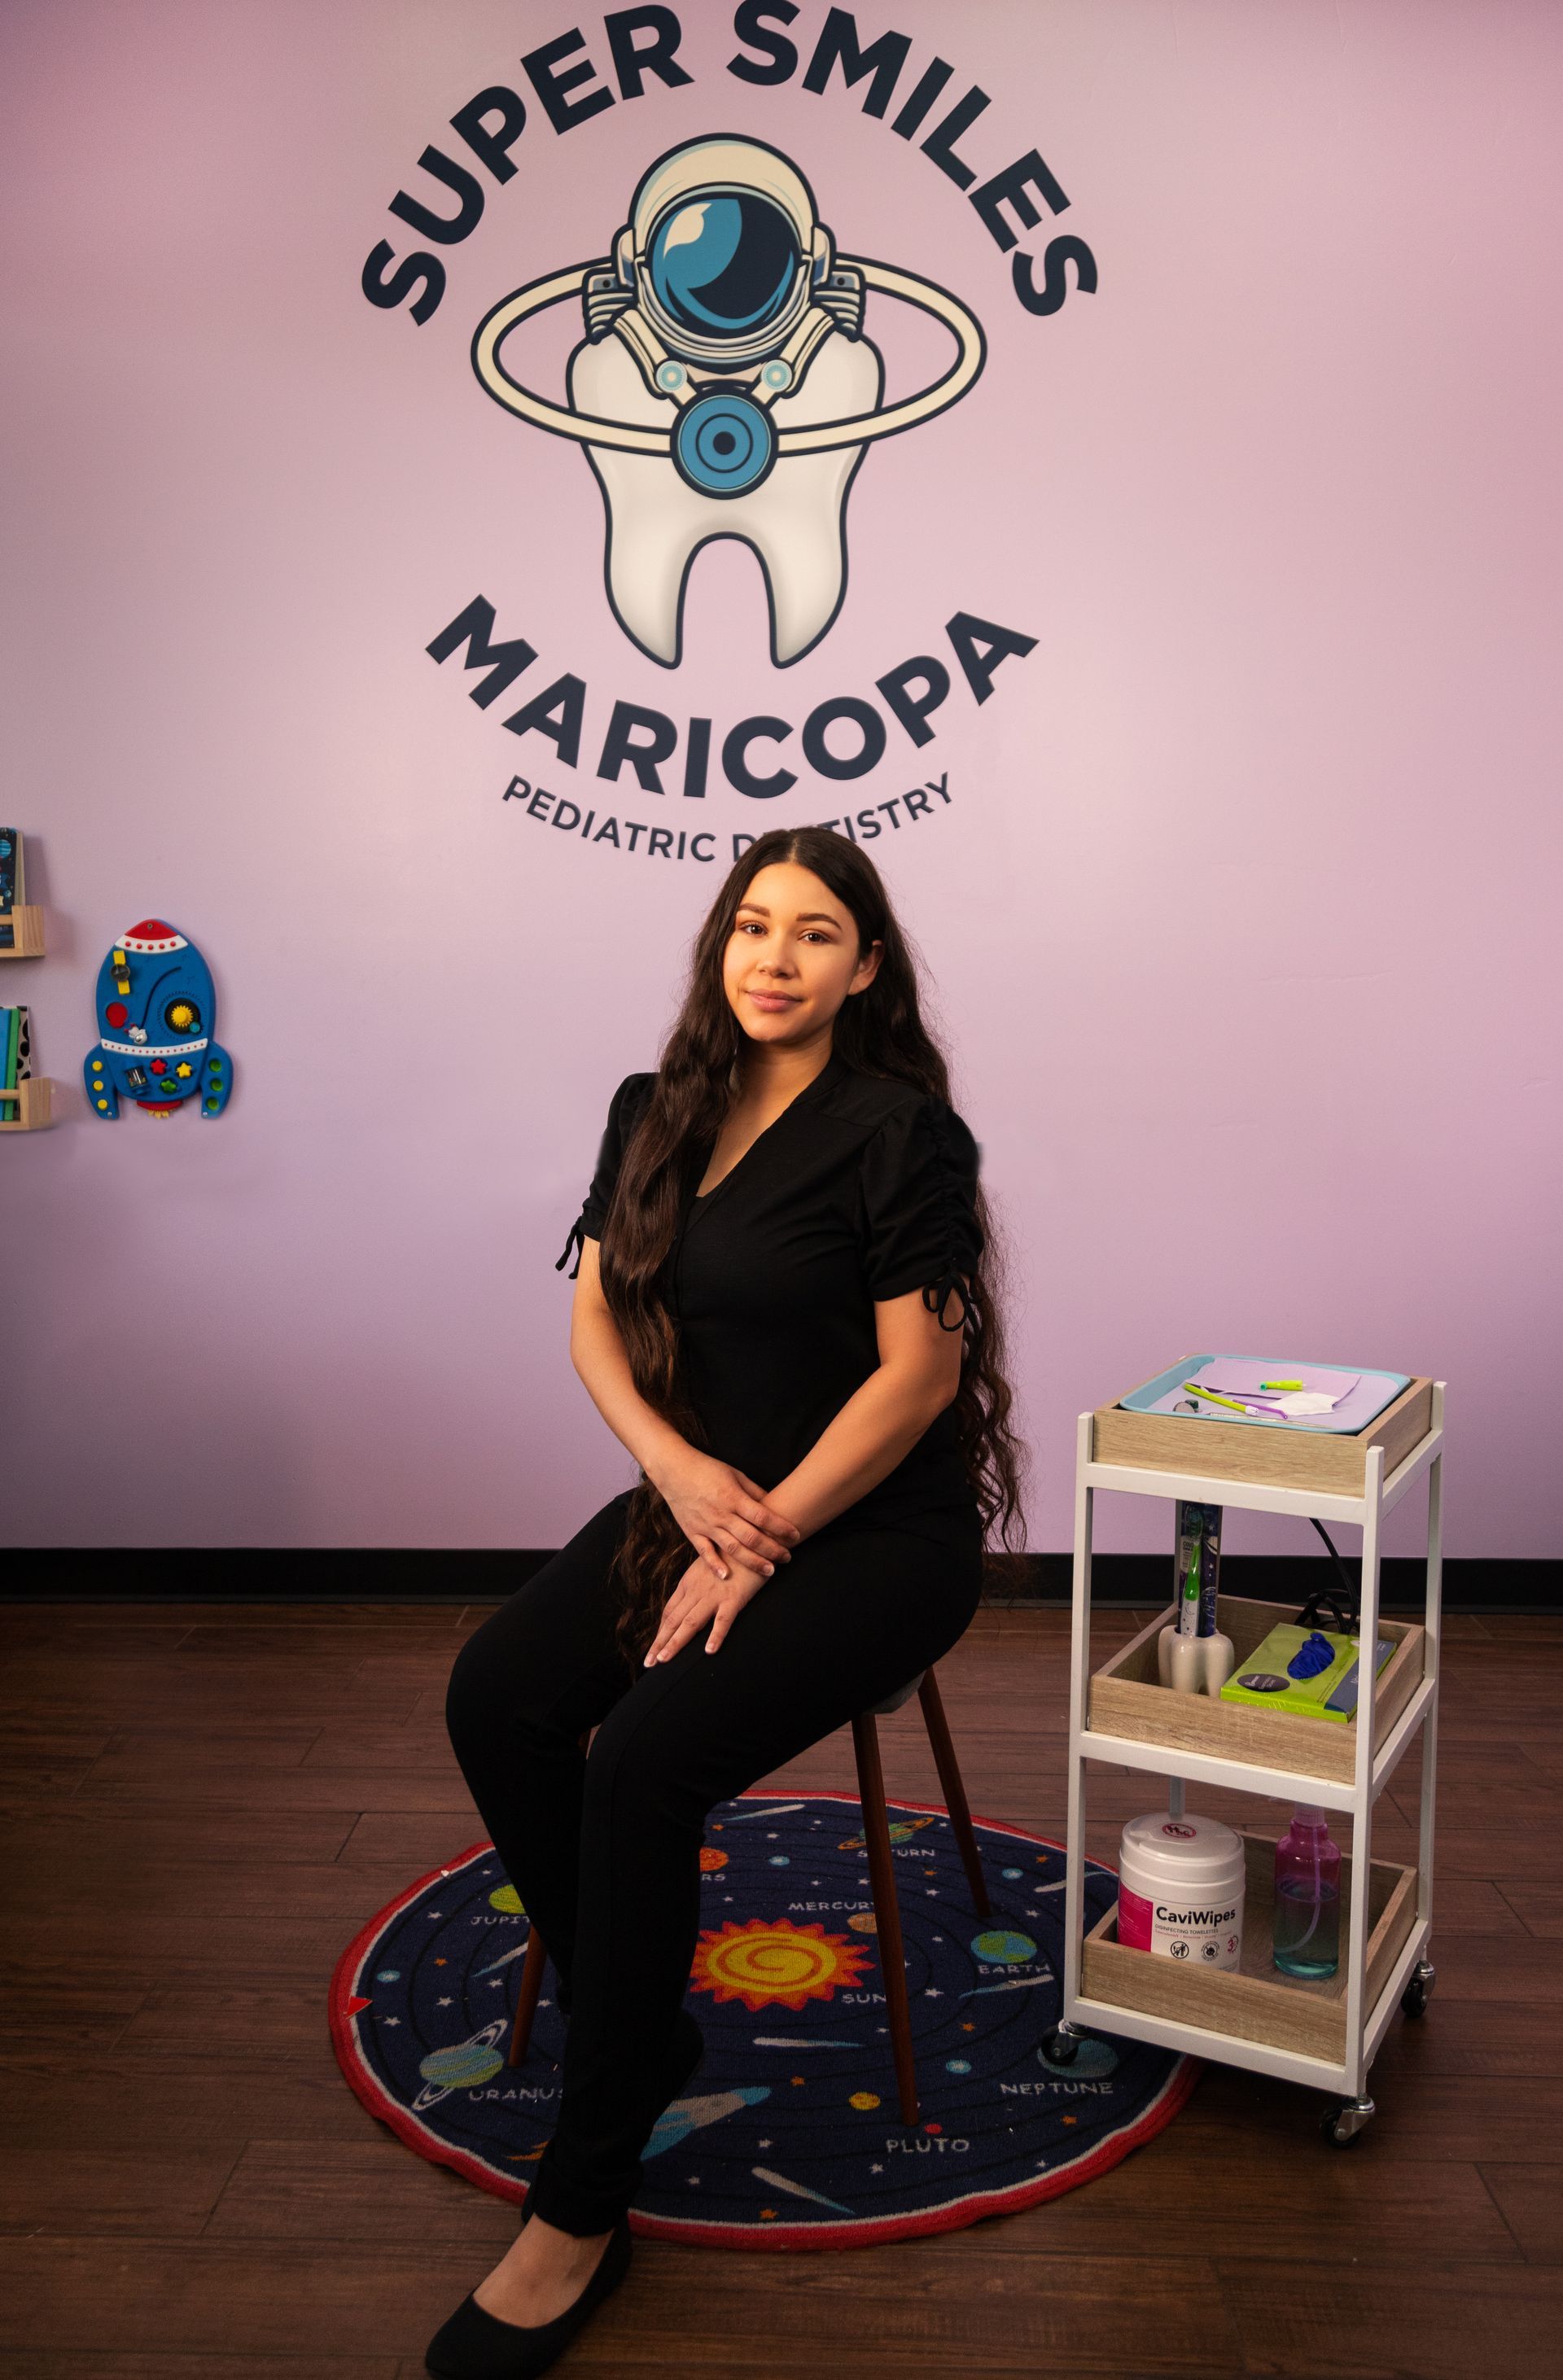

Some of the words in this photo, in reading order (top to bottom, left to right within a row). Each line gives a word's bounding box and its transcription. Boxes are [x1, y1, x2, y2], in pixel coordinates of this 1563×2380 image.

[361, 4, 695, 327] SUPER
[726, 0, 1098, 317] SMILES
[425, 593, 1040, 799] MARICOPA
[501, 774, 716, 863] PEDIATRIC
[857, 1848, 935, 1858] SURN
[788, 1901, 874, 1910] MERCUR
[1156, 1906, 1236, 1927] CaviWipes
[1154, 1923, 1189, 1935] DISINFECTING
[977, 1962, 1052, 1975] EARTH
[841, 1993, 887, 2004] SUN
[1000, 2081, 1114, 2096] NEPTUNE
[886, 2137, 970, 2154] PLUTO
